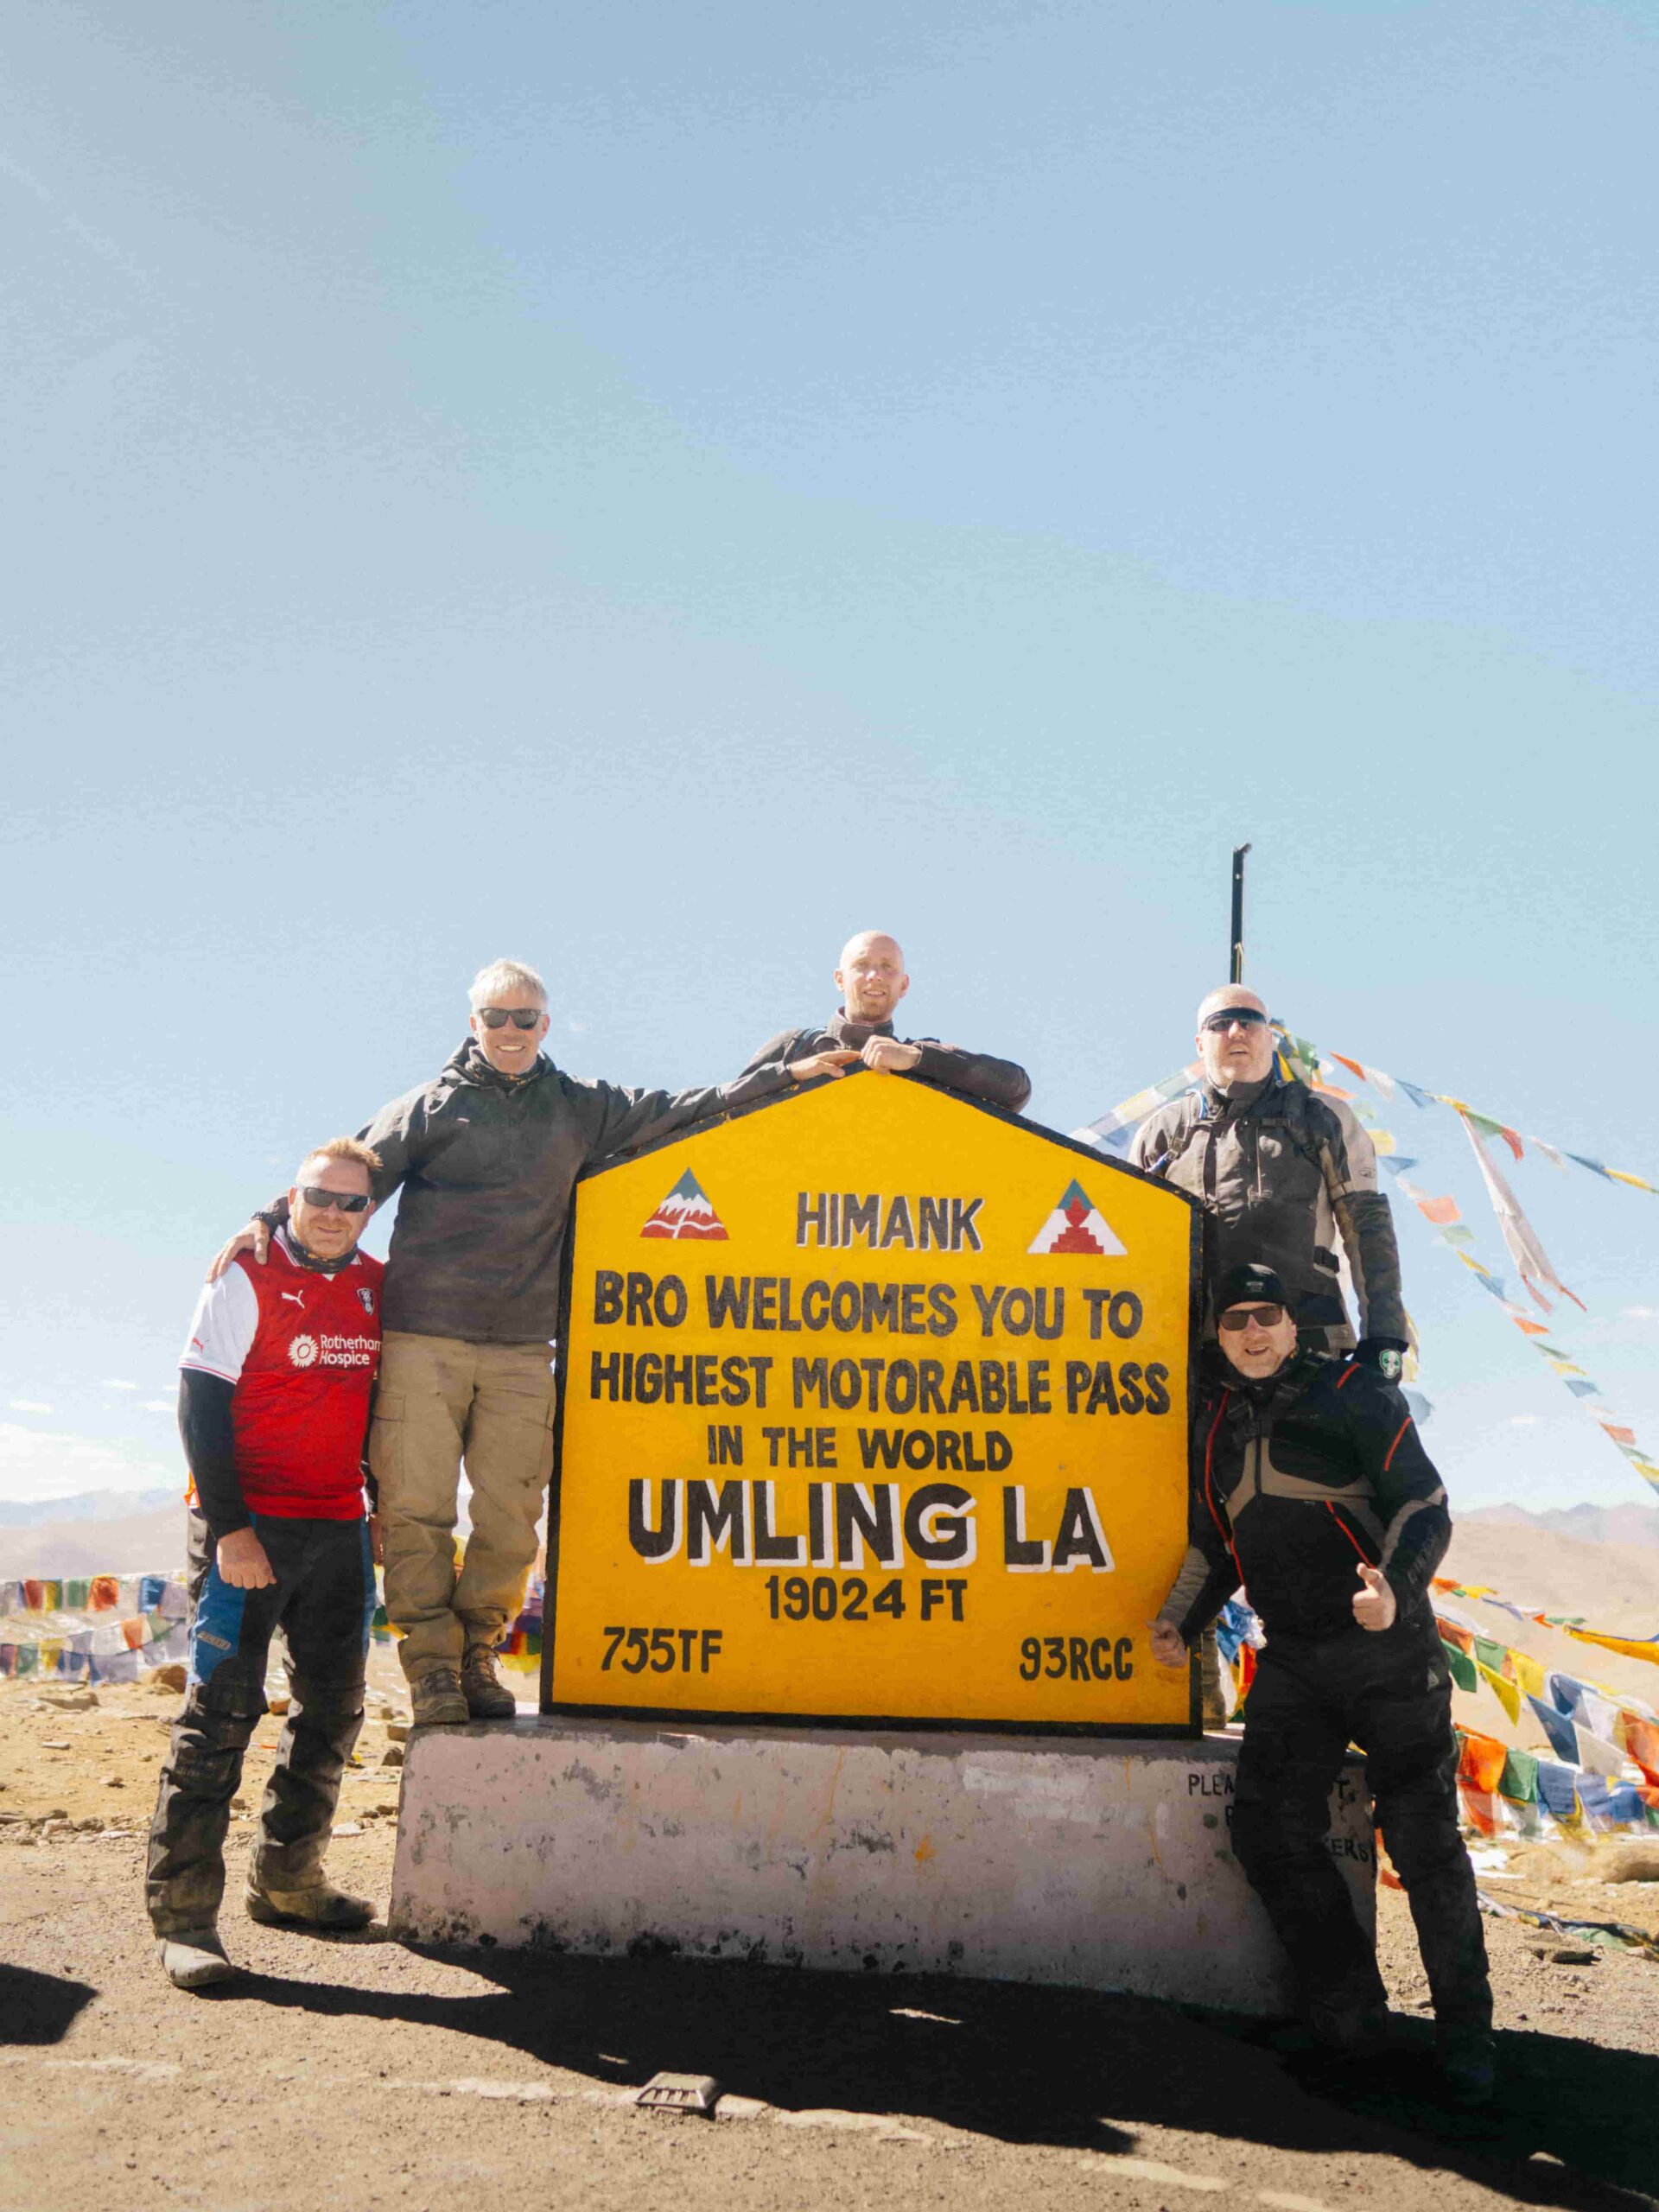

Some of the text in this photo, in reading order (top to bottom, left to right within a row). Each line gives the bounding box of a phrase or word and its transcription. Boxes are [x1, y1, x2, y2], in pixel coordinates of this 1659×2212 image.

[797, 1192, 985, 1252] HIMANK
[594, 1270, 1143, 1340] BRO WELCOMES YOU TO
[319, 1351, 370, 1368] Hospice
[590, 1351, 1171, 1415] HIGHEST MOTORABLE PASS
[708, 1425, 1013, 1472] IN THE WORLD
[628, 1478, 1115, 1573] UMLING LA
[765, 1575, 968, 1622] 19024 FT
[601, 1626, 722, 1675] 755TF
[1019, 1637, 1134, 1682] 93RCC
[1188, 1773, 1235, 1796] PLEA
